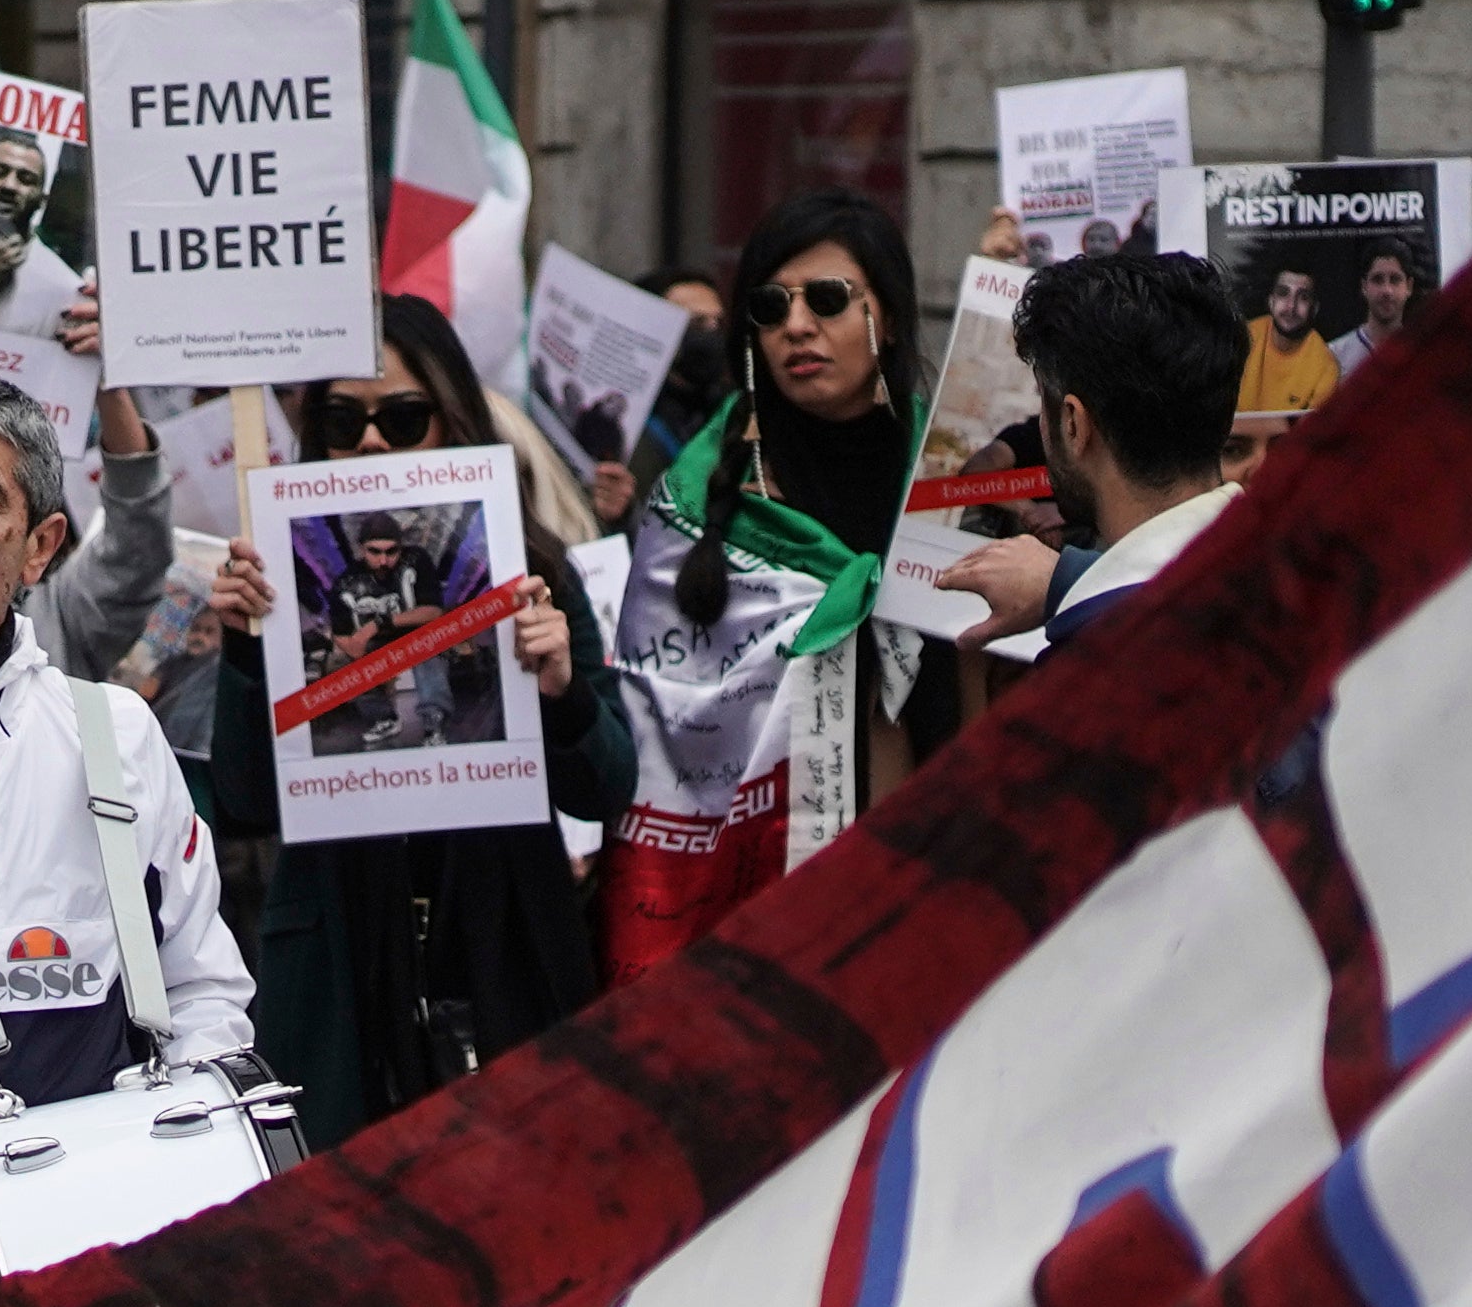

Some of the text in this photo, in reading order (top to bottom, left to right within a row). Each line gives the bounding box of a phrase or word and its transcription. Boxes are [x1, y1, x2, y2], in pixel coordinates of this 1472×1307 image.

[128, 76, 333, 129] FEMME
[186, 150, 279, 198] VIE
[1226, 190, 1426, 227] REST IN POWER
[129, 204, 346, 275] LIBERTÉ
[974, 271, 1020, 300] #Ma
[186, 329, 237, 345] National
[240, 329, 284, 342] Femme
[286, 326, 305, 340] Vie
[272, 458, 495, 501] #mohsen_shekari
[941, 475, 1007, 500] Exécuté
[1009, 476, 1037, 498] par
[895, 557, 944, 590] emp
[301, 671, 367, 710] Exécuté
[363, 656, 391, 683] par
[391, 646, 407, 666] le
[406, 621, 461, 664] régime
[287, 755, 539, 799] empêchons la tuerie
